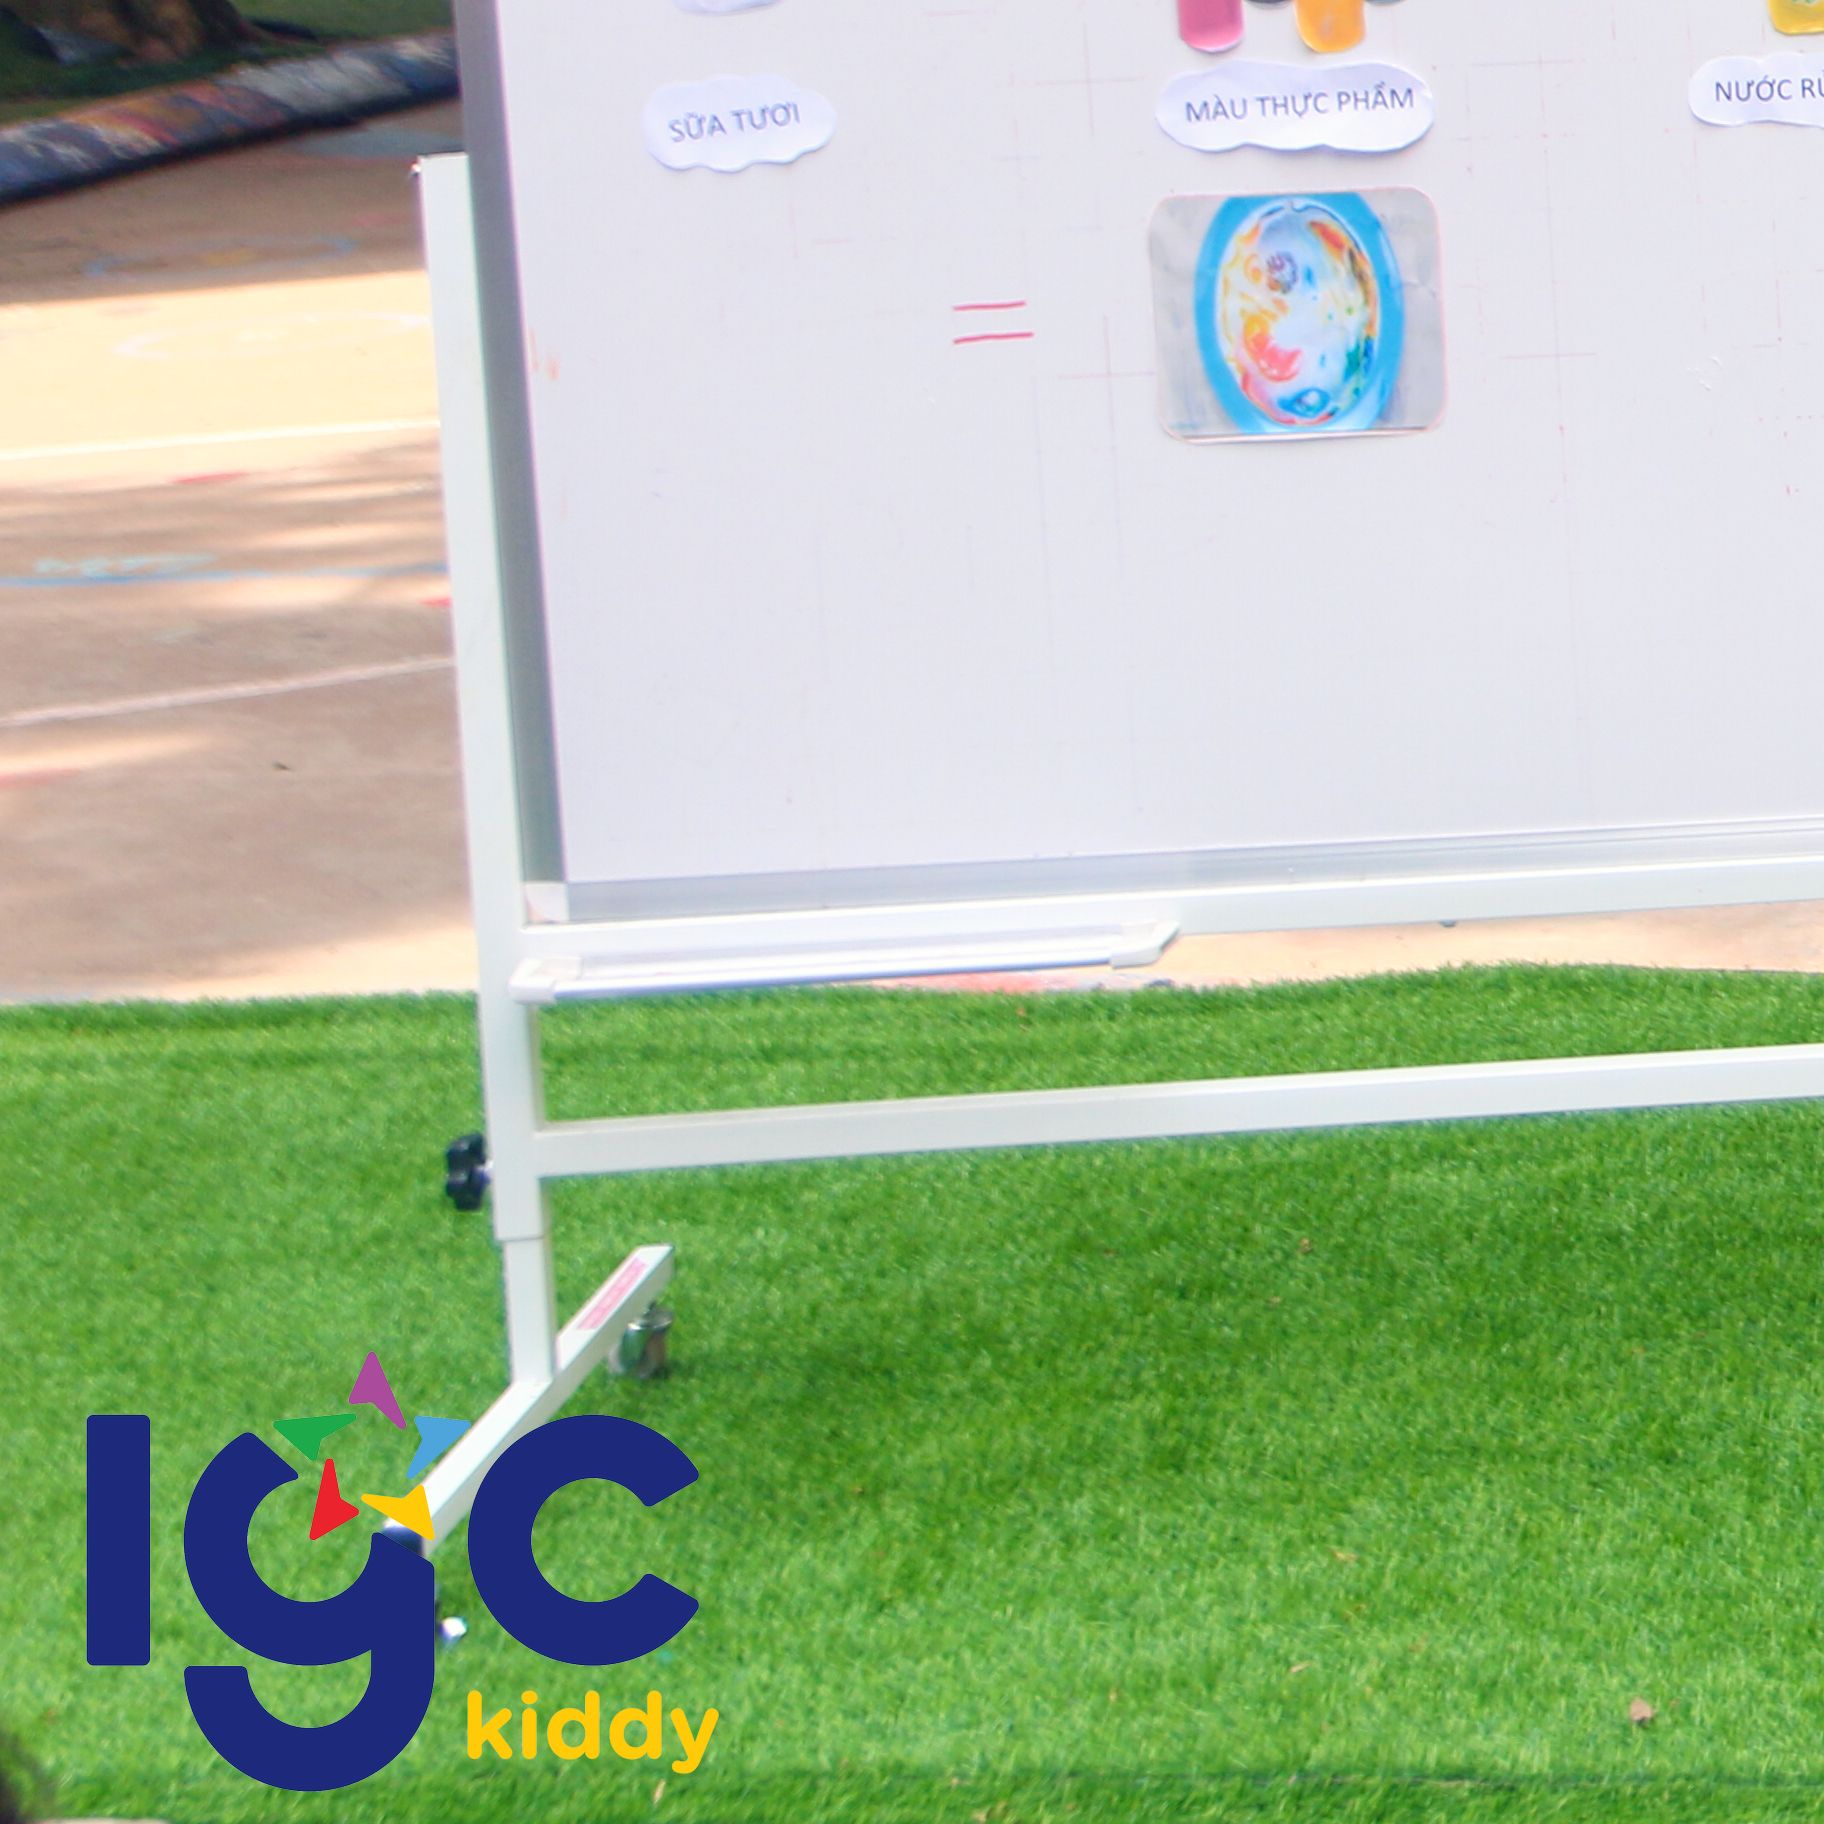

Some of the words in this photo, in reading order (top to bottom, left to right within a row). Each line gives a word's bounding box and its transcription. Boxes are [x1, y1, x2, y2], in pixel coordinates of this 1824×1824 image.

[1184, 93, 1248, 123] MÀU
[1254, 90, 1329, 118] THỰC
[1336, 79, 1415, 111] PHẨM
[1714, 74, 1793, 103] NƯỚC
[668, 111, 727, 143] SỮA
[730, 102, 801, 132] TƯƠI
